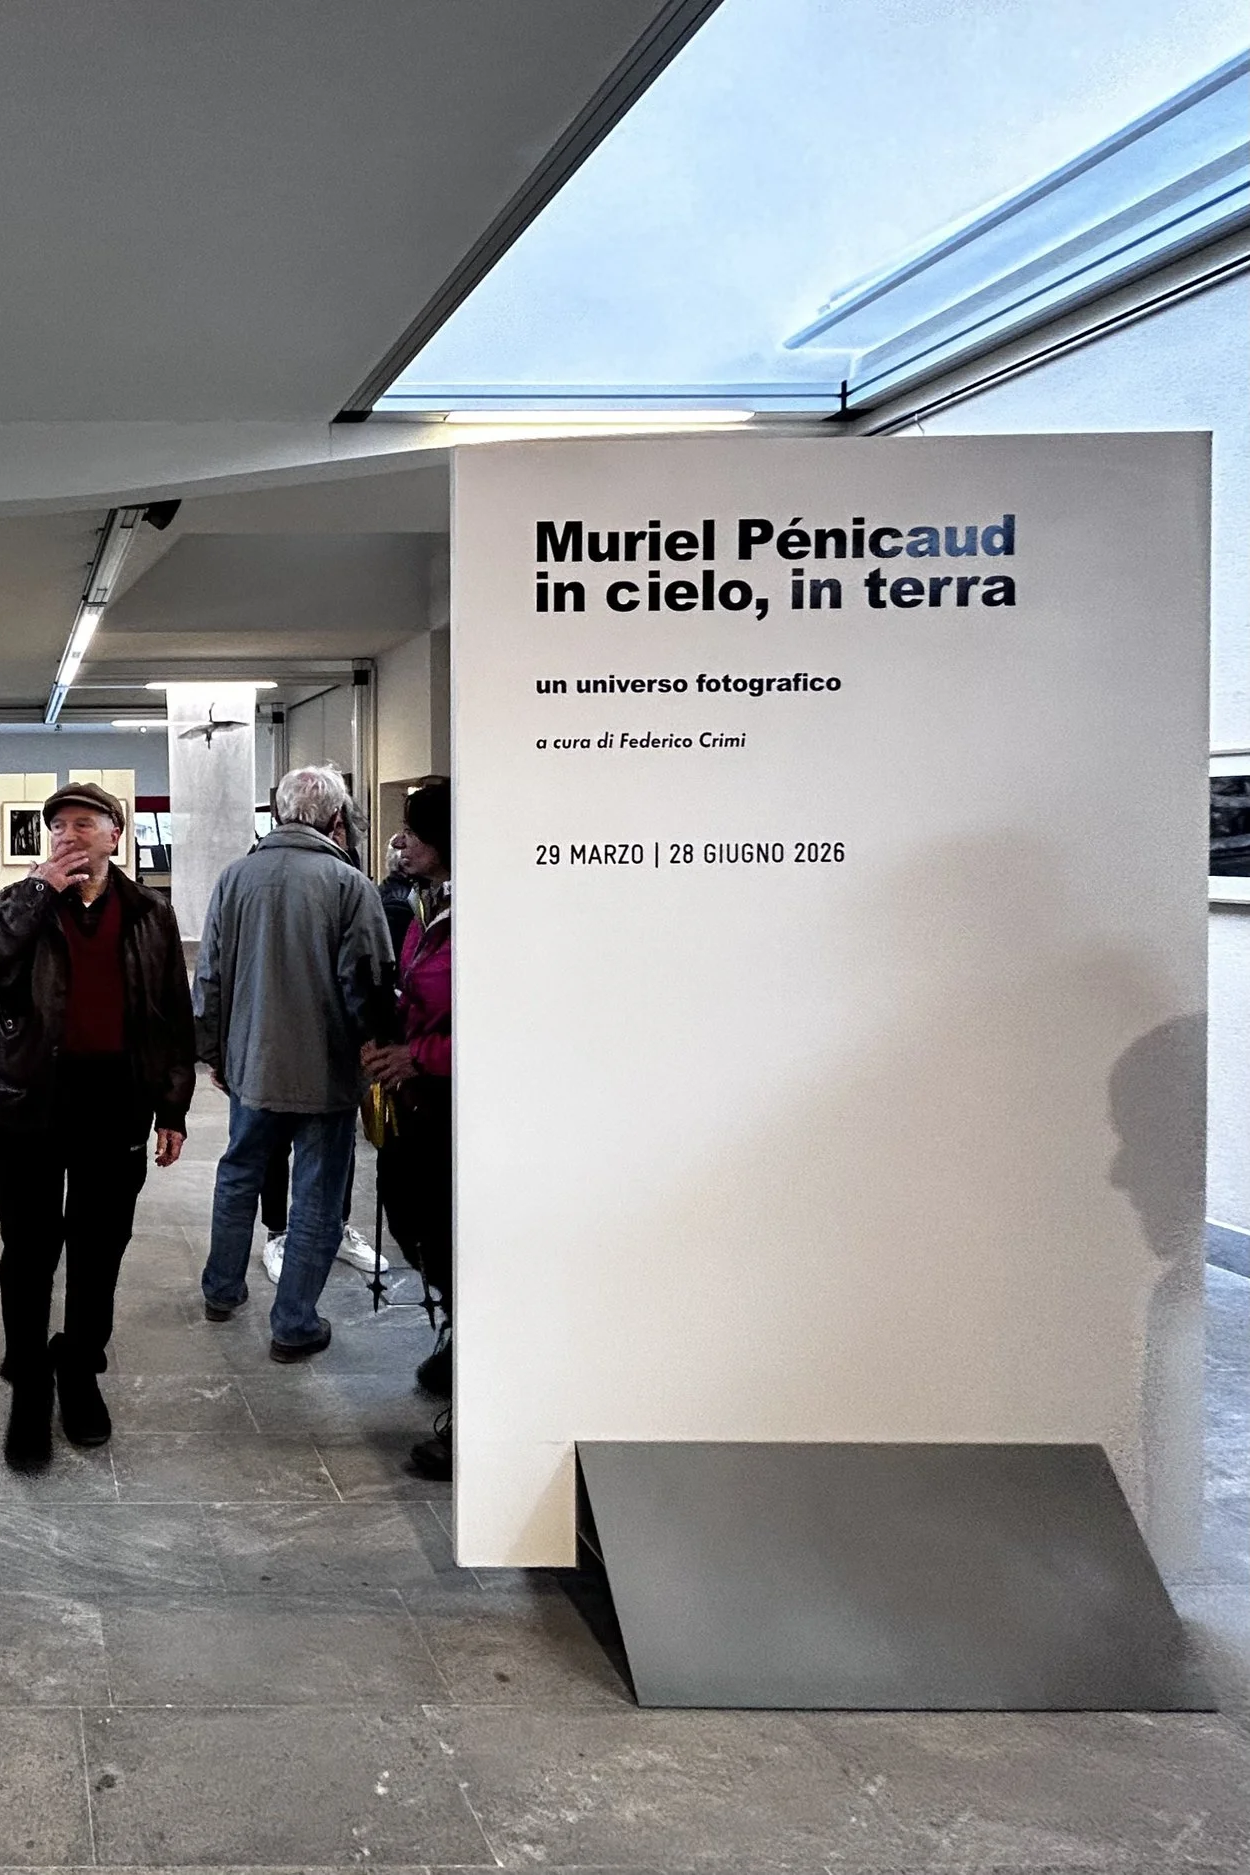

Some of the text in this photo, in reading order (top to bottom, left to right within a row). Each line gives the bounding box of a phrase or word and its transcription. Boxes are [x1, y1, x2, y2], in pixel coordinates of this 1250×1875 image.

[537, 513, 1016, 563] Muriel Pénicaud
[536, 566, 1017, 622] in cielo, in terra
[536, 672, 842, 698] un universo fotografico
[536, 730, 747, 750] a cura di Federico Crimi
[536, 844, 561, 866] 29
[570, 843, 644, 865] MARZO
[669, 843, 694, 865] 28
[703, 842, 785, 865] GIUGNO
[794, 841, 846, 864] 2026
